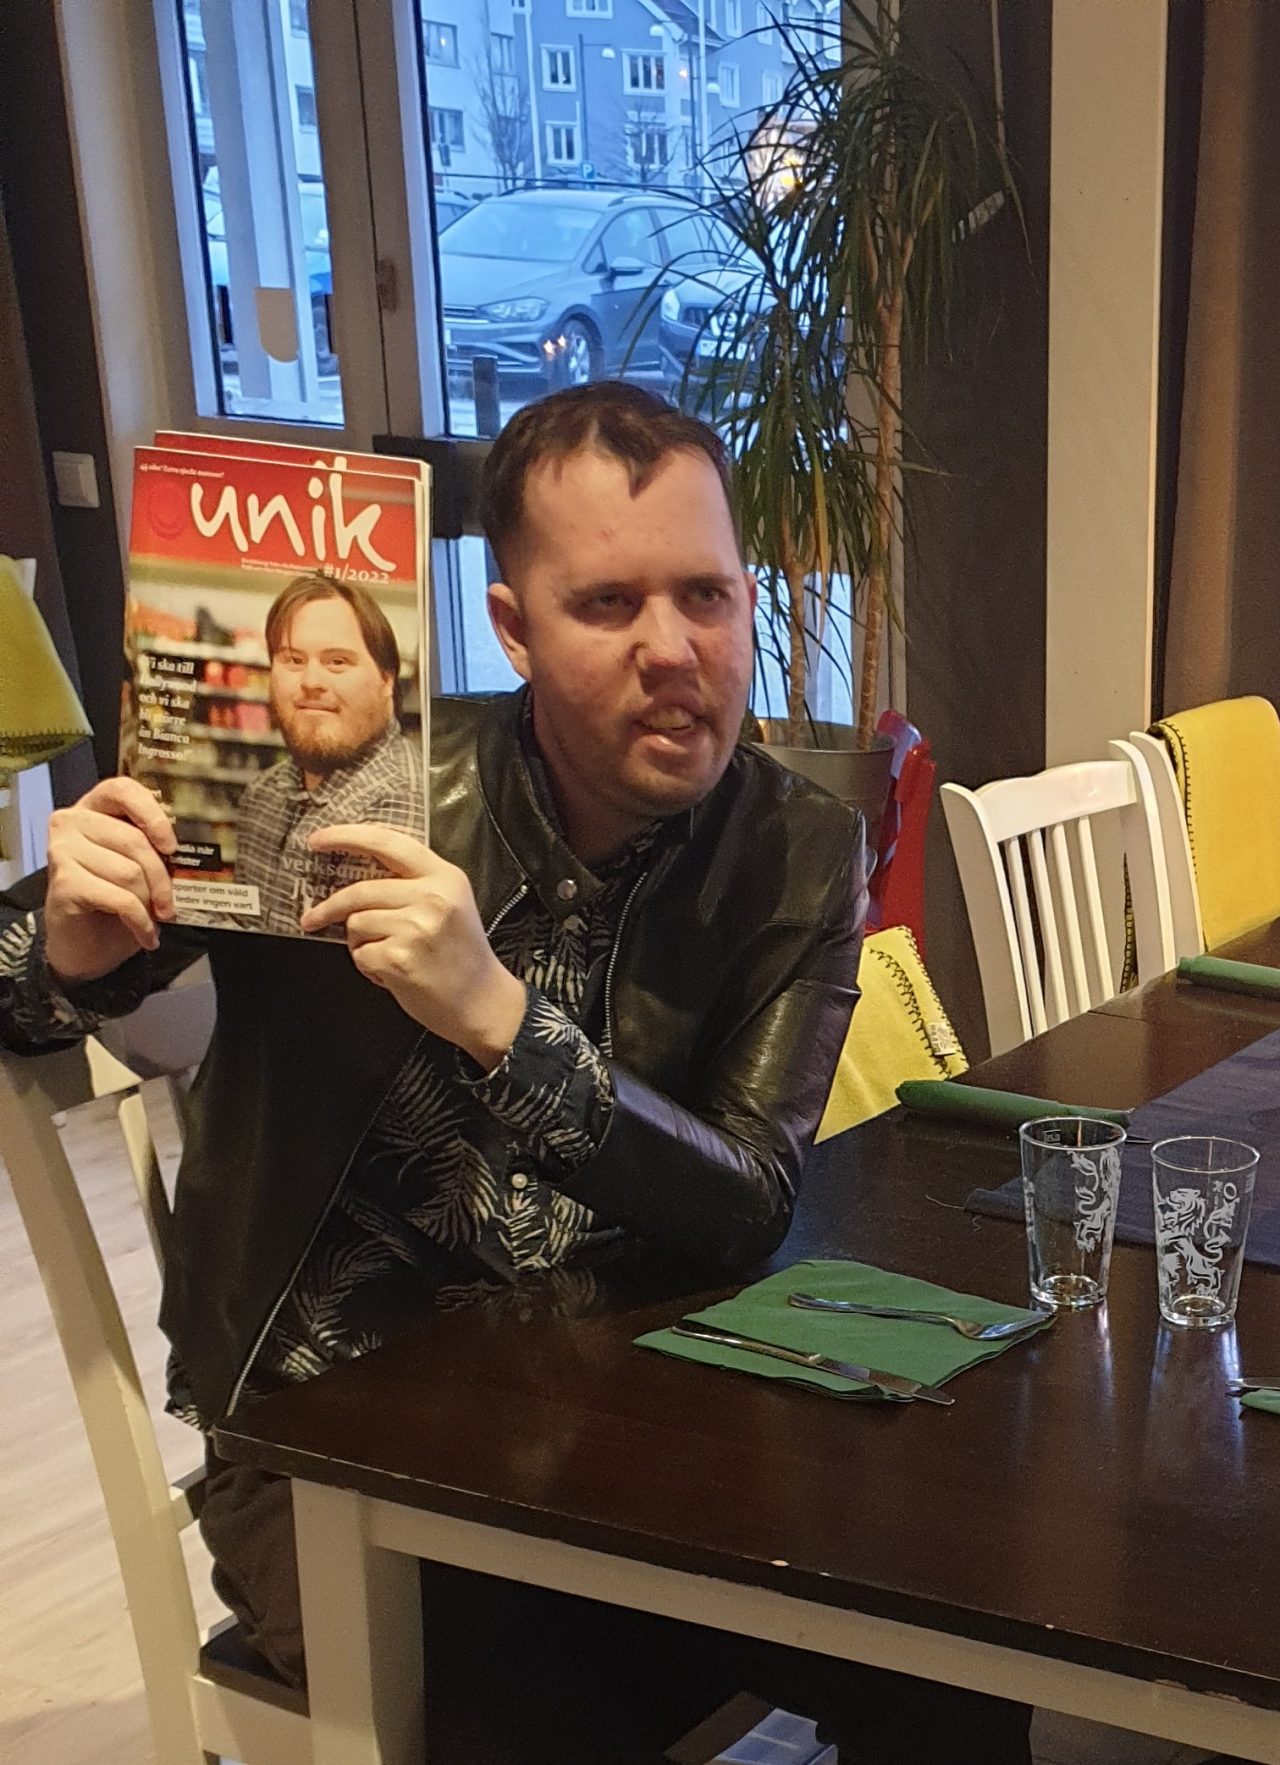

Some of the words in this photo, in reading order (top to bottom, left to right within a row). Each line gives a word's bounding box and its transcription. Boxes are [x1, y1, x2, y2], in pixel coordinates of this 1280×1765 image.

[582, 164, 593, 179] P
[190, 472, 397, 572] unik
[324, 562, 390, 584] #1/2022
